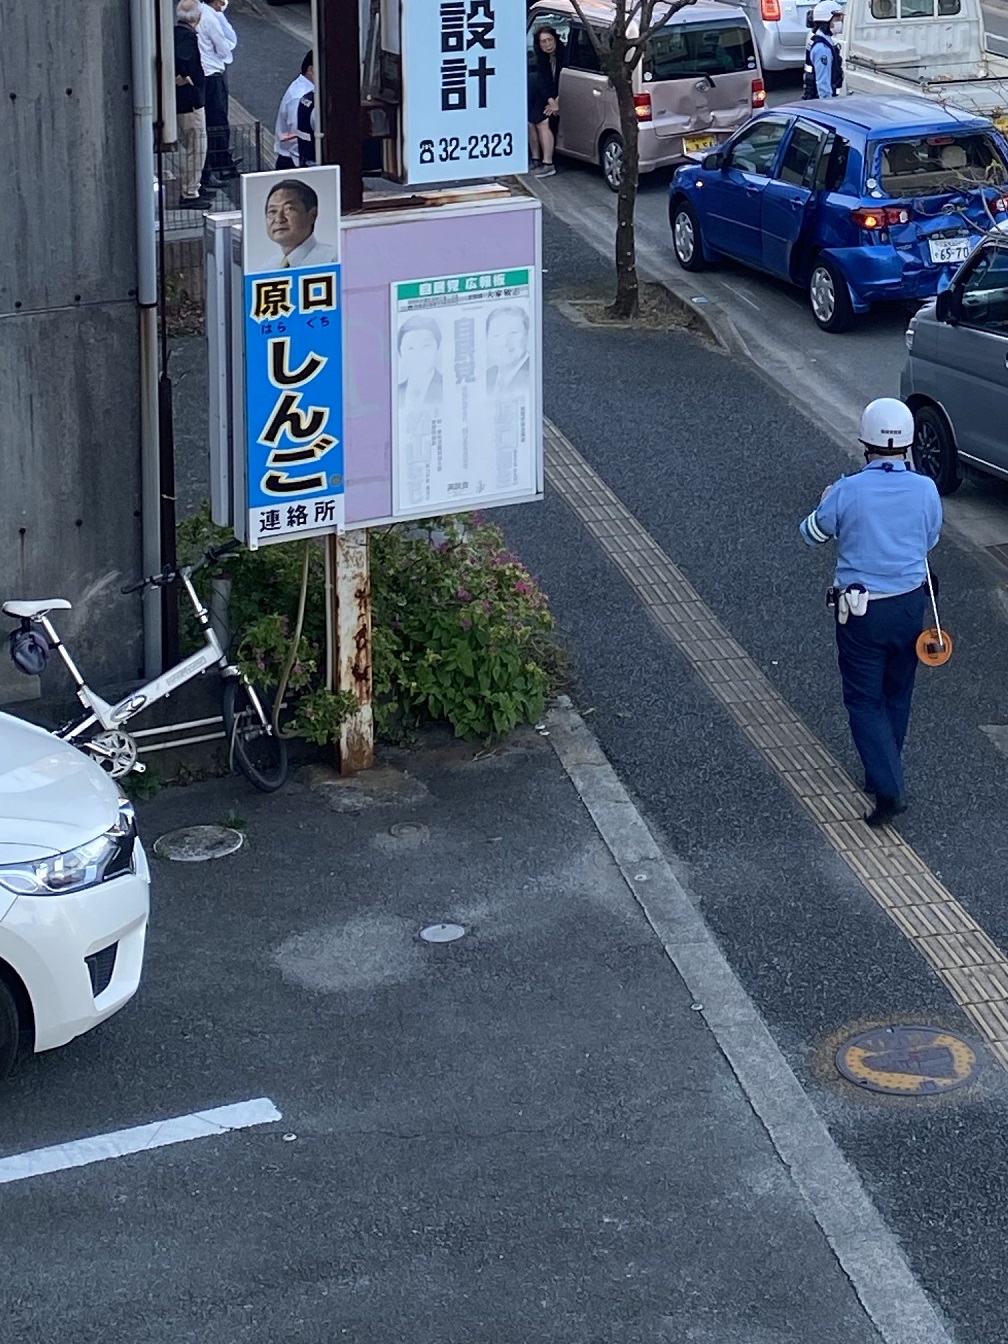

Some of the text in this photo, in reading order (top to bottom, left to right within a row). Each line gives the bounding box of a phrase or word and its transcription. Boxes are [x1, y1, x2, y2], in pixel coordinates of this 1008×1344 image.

[438, 132, 514, 164] 32-2323
[251, 272, 338, 322] 原口
[261, 316, 331, 335] はら ぐち
[257, 337, 339, 496] しんご
[259, 499, 336, 533] 連絡所
